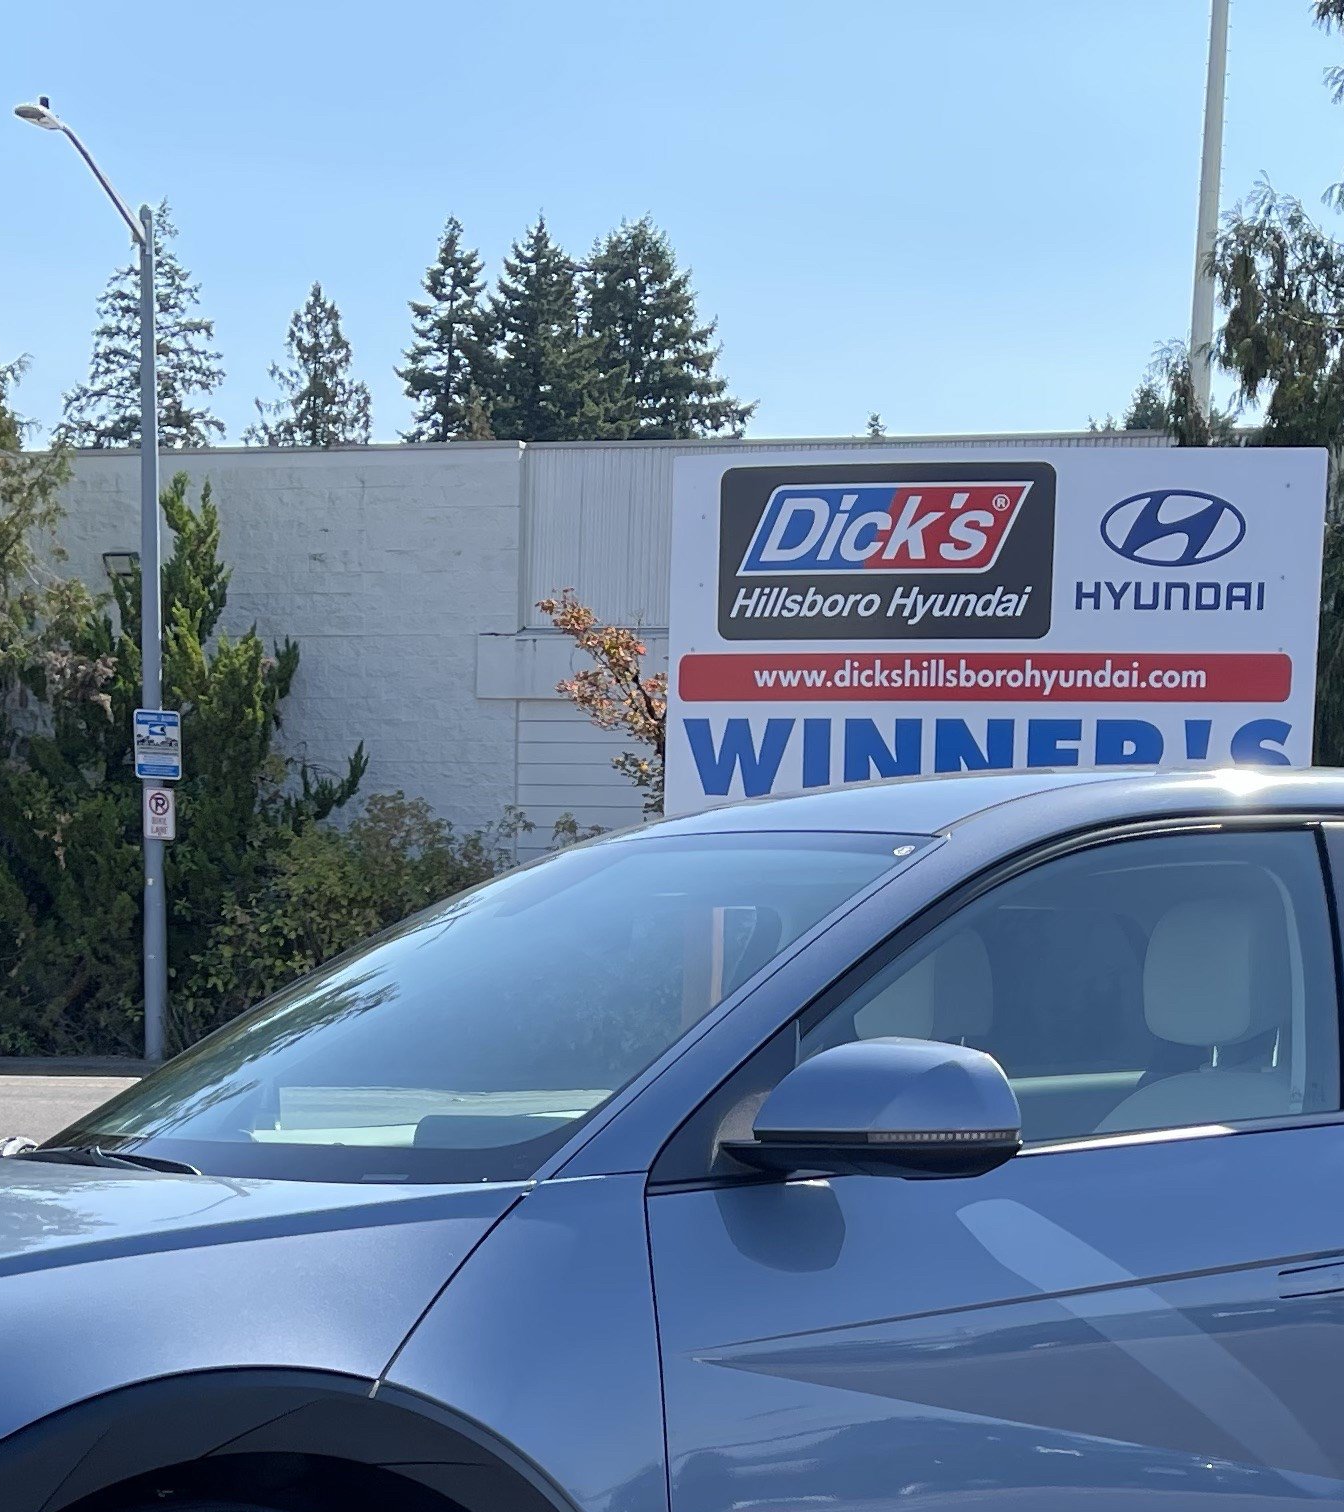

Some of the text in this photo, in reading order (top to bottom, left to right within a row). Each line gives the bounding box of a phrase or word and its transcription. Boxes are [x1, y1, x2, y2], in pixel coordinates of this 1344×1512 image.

[759, 493, 995, 562] Dick's
[730, 586, 1029, 625] Hillsboro Hyundai
[1074, 580, 1266, 612] HYUNDAI
[753, 659, 1206, 696] www.dickshillsborohyundai.com
